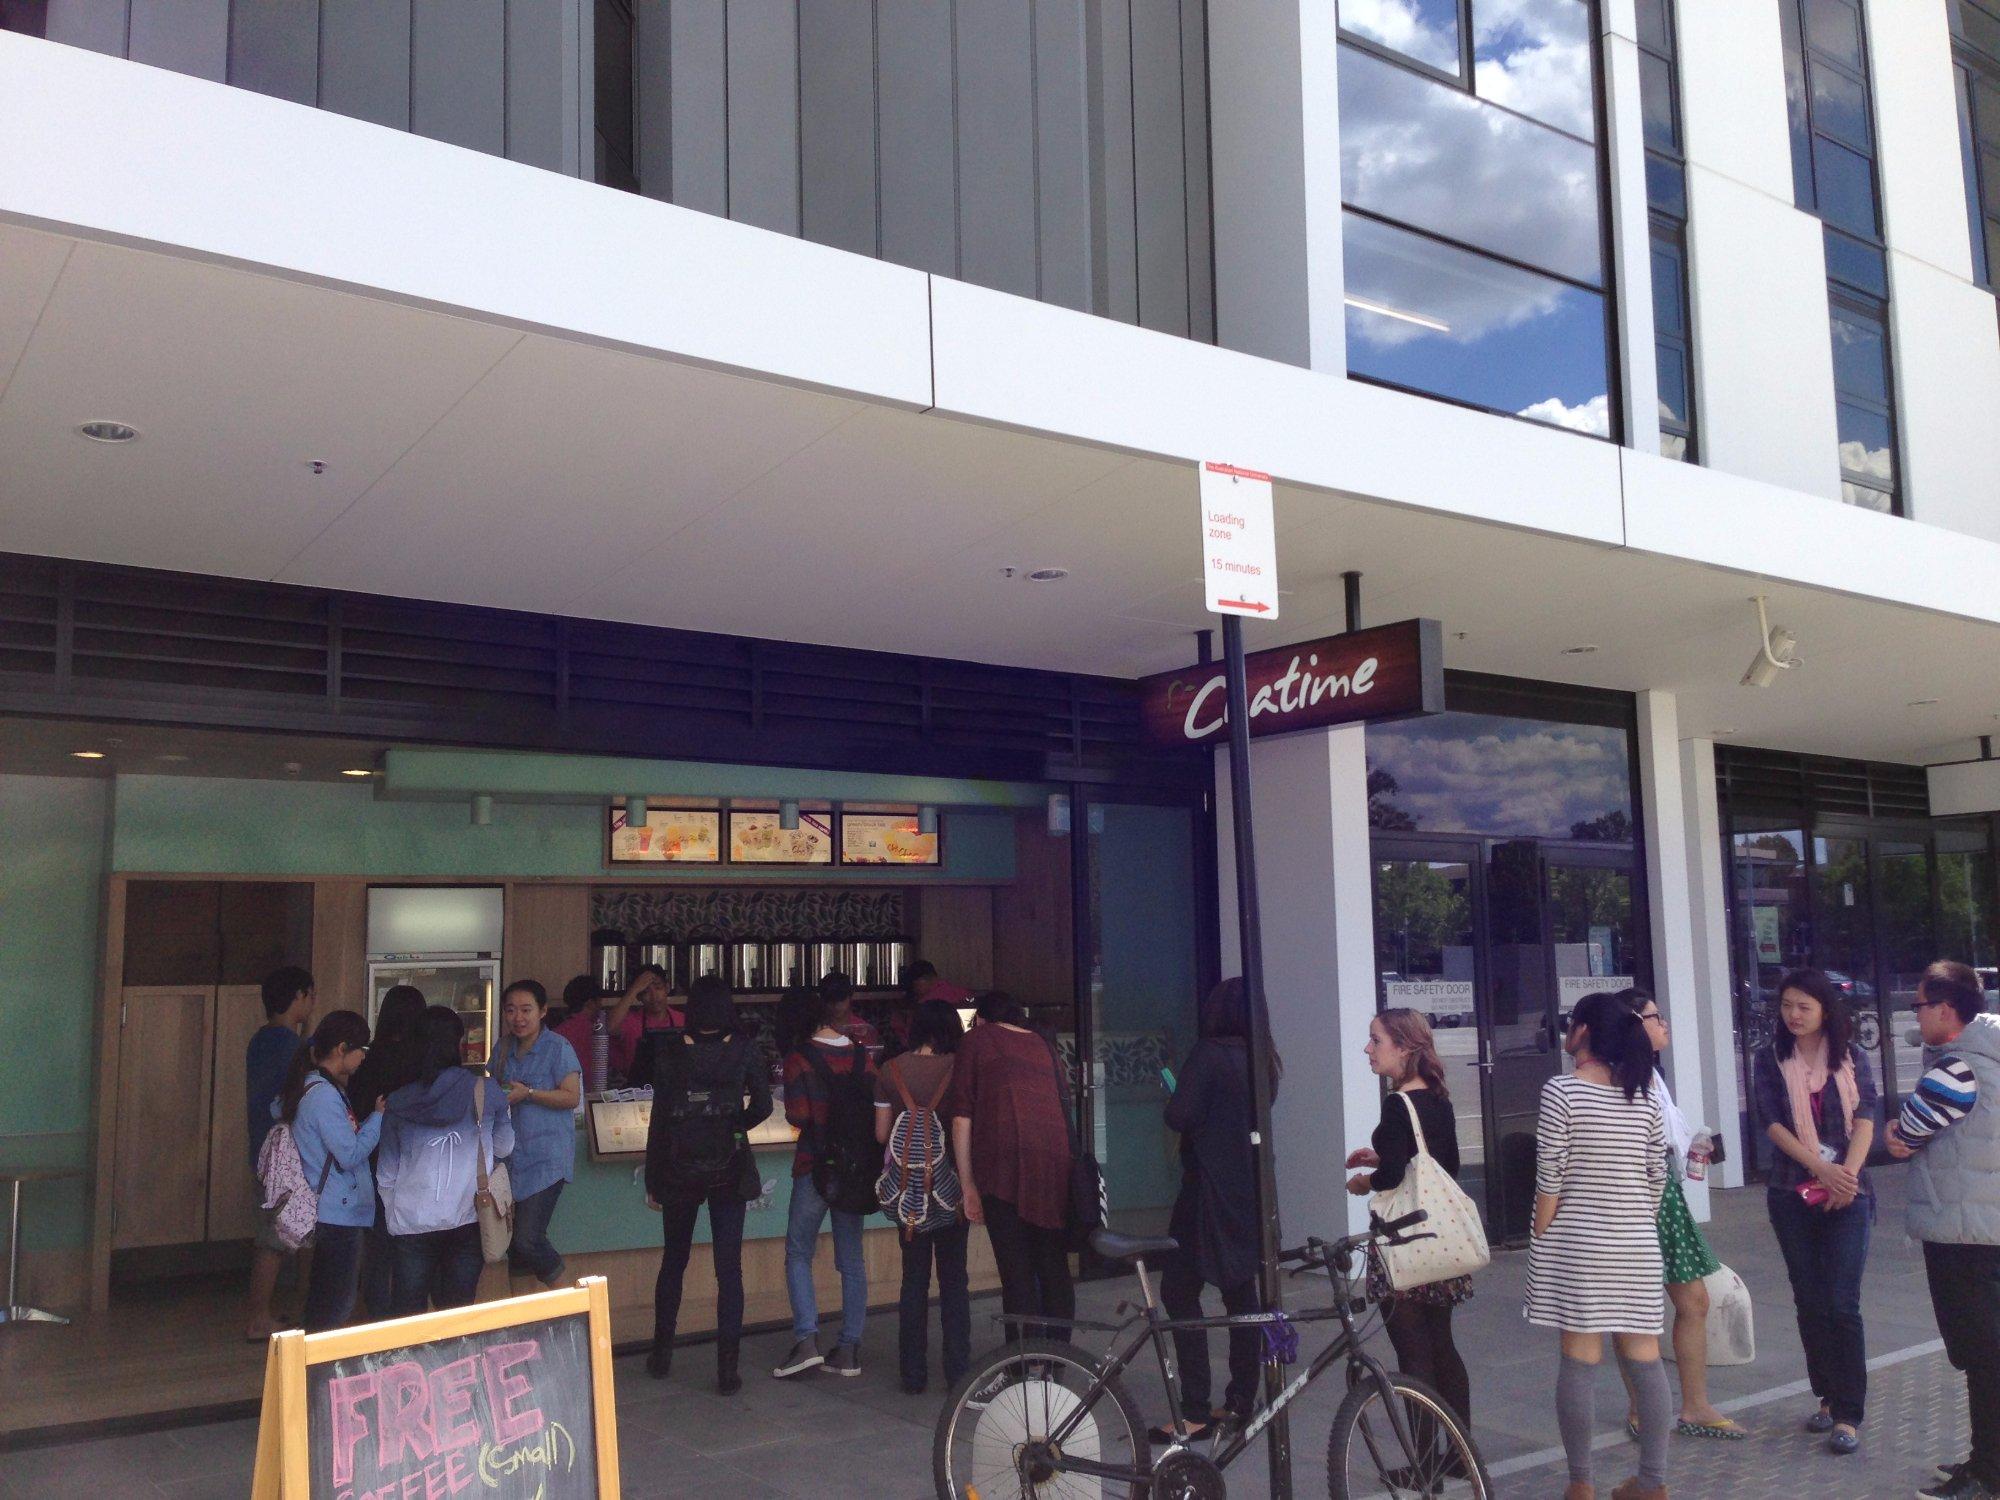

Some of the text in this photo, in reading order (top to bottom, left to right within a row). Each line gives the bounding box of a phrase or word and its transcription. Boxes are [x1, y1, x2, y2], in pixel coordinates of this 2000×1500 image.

[1208, 510, 1245, 529] Loading
[1209, 527, 1232, 540] zone
[1212, 558, 1261, 576] 15 minutes
[1184, 654, 1378, 739] Catime
[1393, 983, 1470, 995] FIRE SAFETY DOOR
[1565, 978, 1632, 989] FIRE SAFETY DOOR
[329, 1339, 543, 1488] FREE
